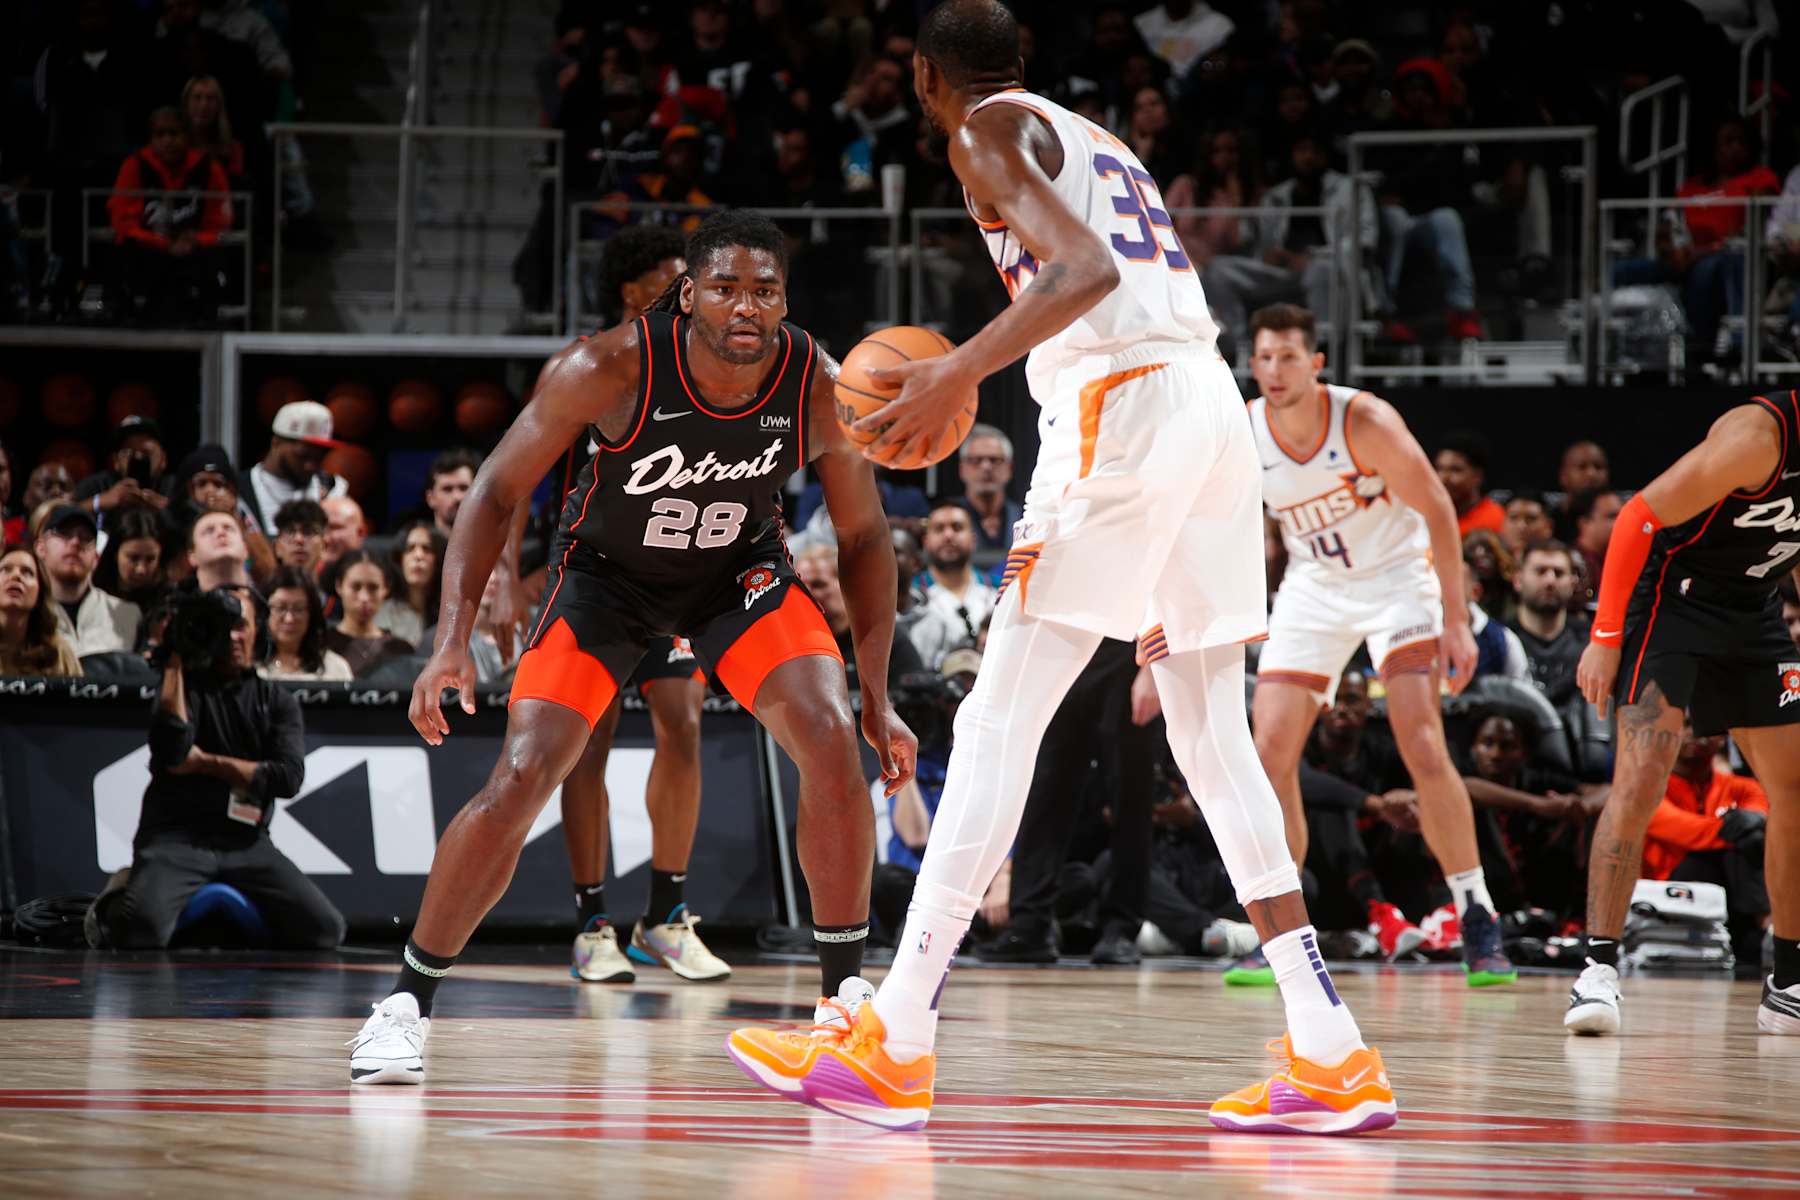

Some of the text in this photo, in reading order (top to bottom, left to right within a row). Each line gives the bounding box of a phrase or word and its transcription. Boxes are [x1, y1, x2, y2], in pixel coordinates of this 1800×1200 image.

[1092, 152, 1193, 272] 35
[760, 415, 791, 428] UWM
[623, 438, 783, 495] Detroit
[643, 497, 748, 549] 28
[1311, 532, 1352, 568] 14
[1745, 541, 1800, 579] 7
[744, 577, 781, 610] Detroit
